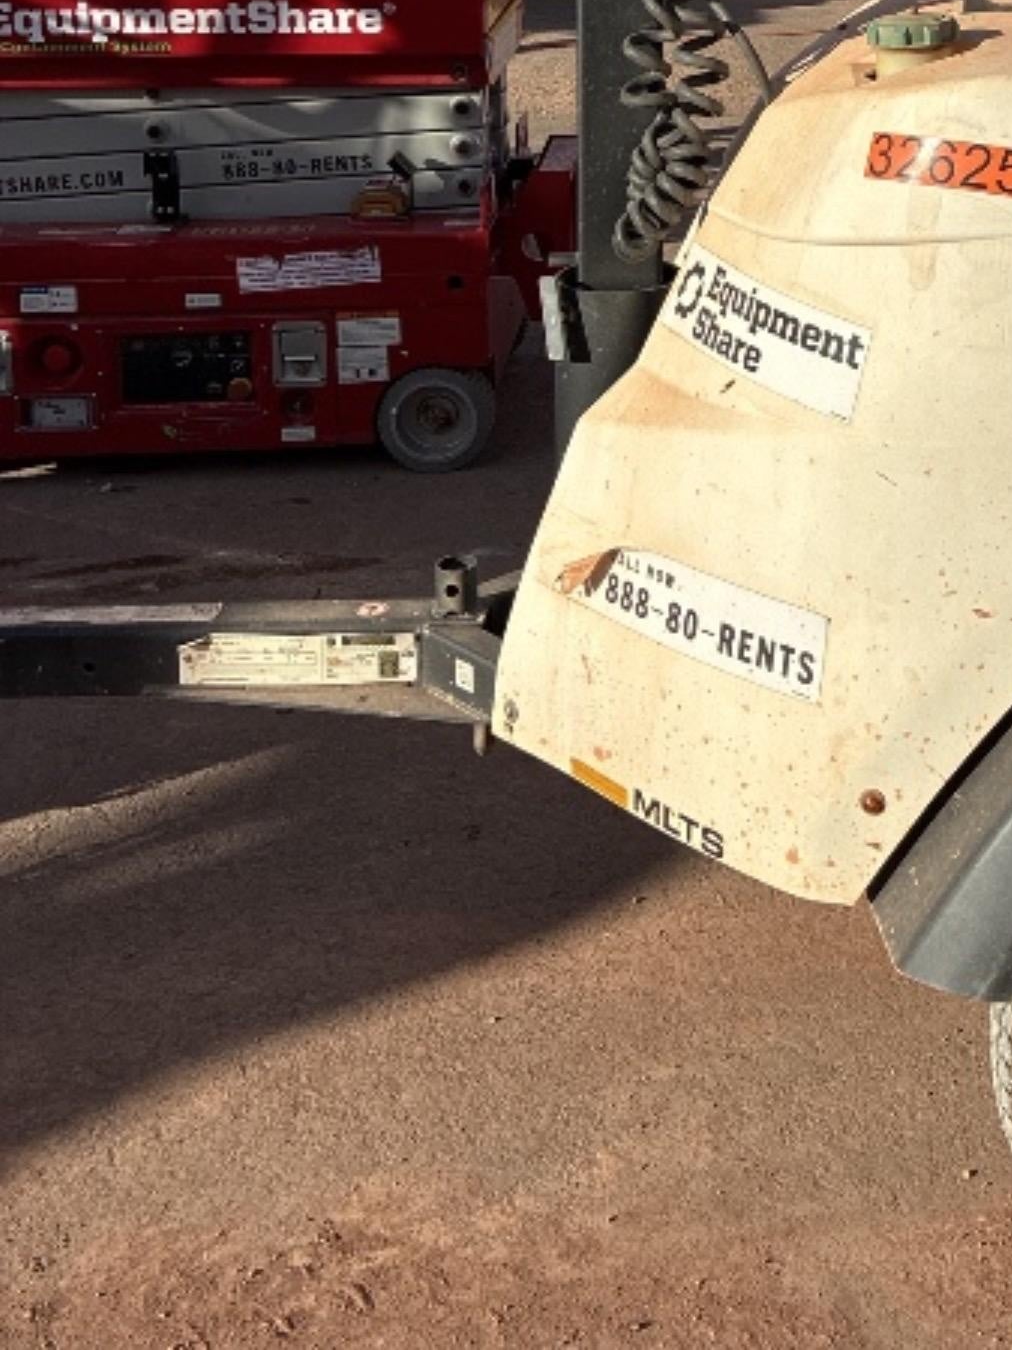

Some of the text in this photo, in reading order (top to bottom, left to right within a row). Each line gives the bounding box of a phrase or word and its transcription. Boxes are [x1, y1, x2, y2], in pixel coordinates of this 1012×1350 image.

[692, 306, 763, 372] Share
[706, 266, 864, 369] Equipment
[604, 573, 816, 685] 888-80-RENTS
[632, 788, 724, 859] MLTS
